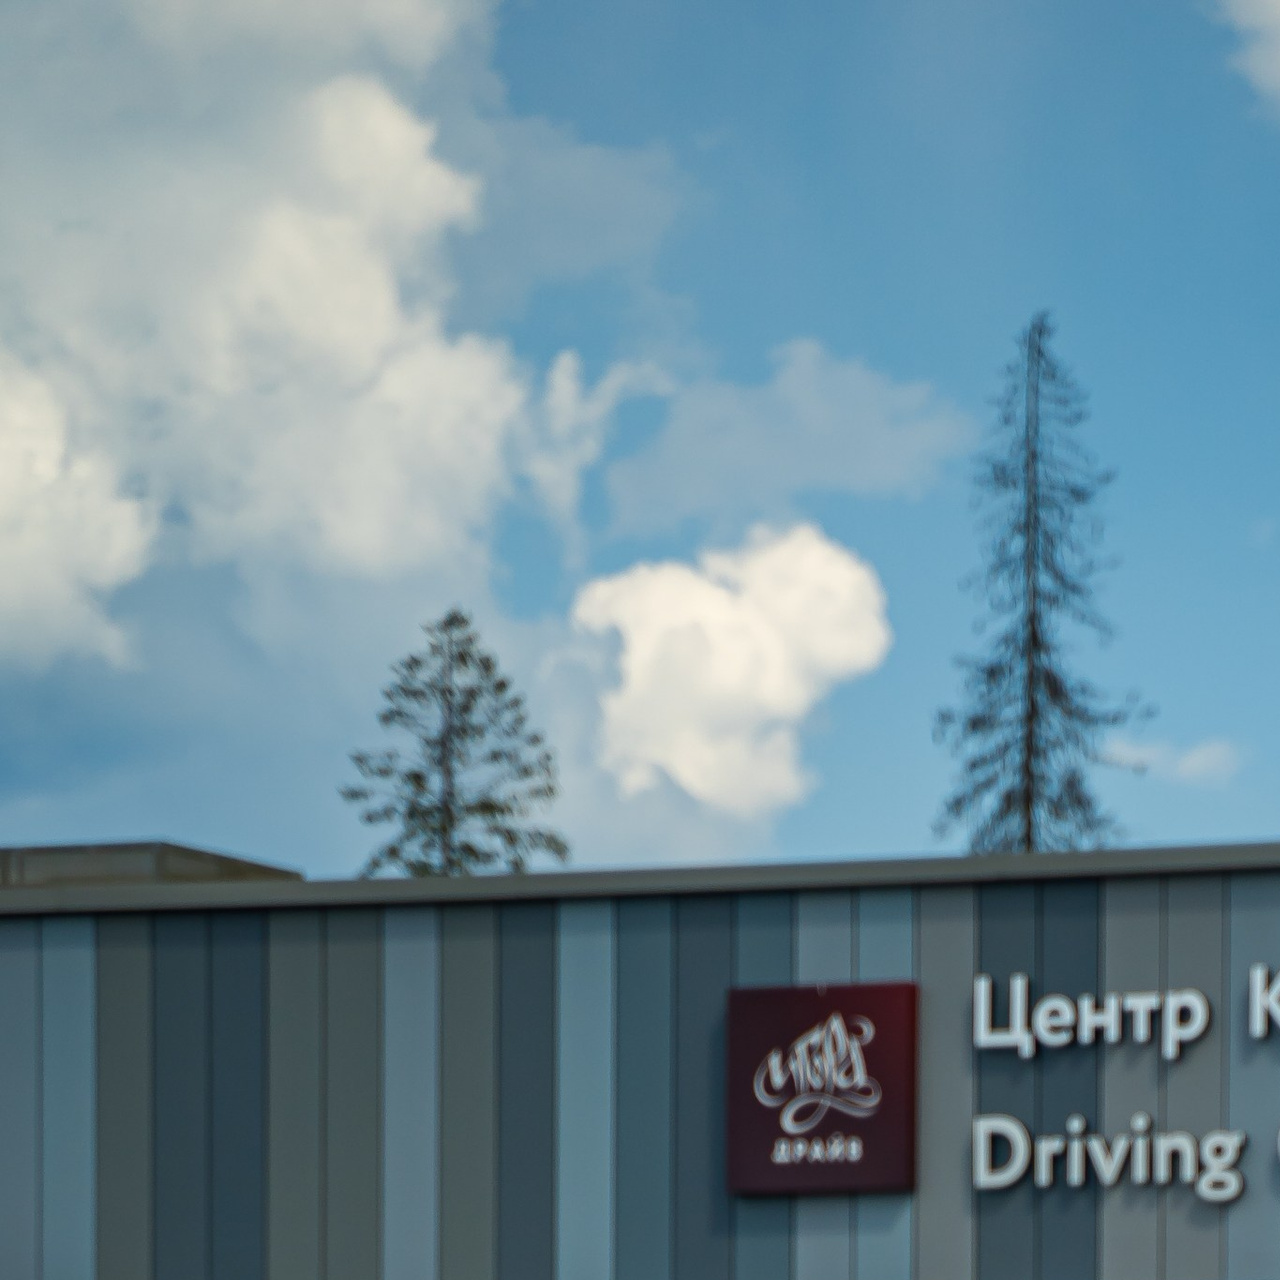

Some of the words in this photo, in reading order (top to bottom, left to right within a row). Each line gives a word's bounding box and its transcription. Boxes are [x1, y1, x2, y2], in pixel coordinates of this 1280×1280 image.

[974, 972, 1209, 1060] Центр
[771, 1131, 863, 1165] ДРАЙВ
[972, 1113, 1245, 1202] Driving
